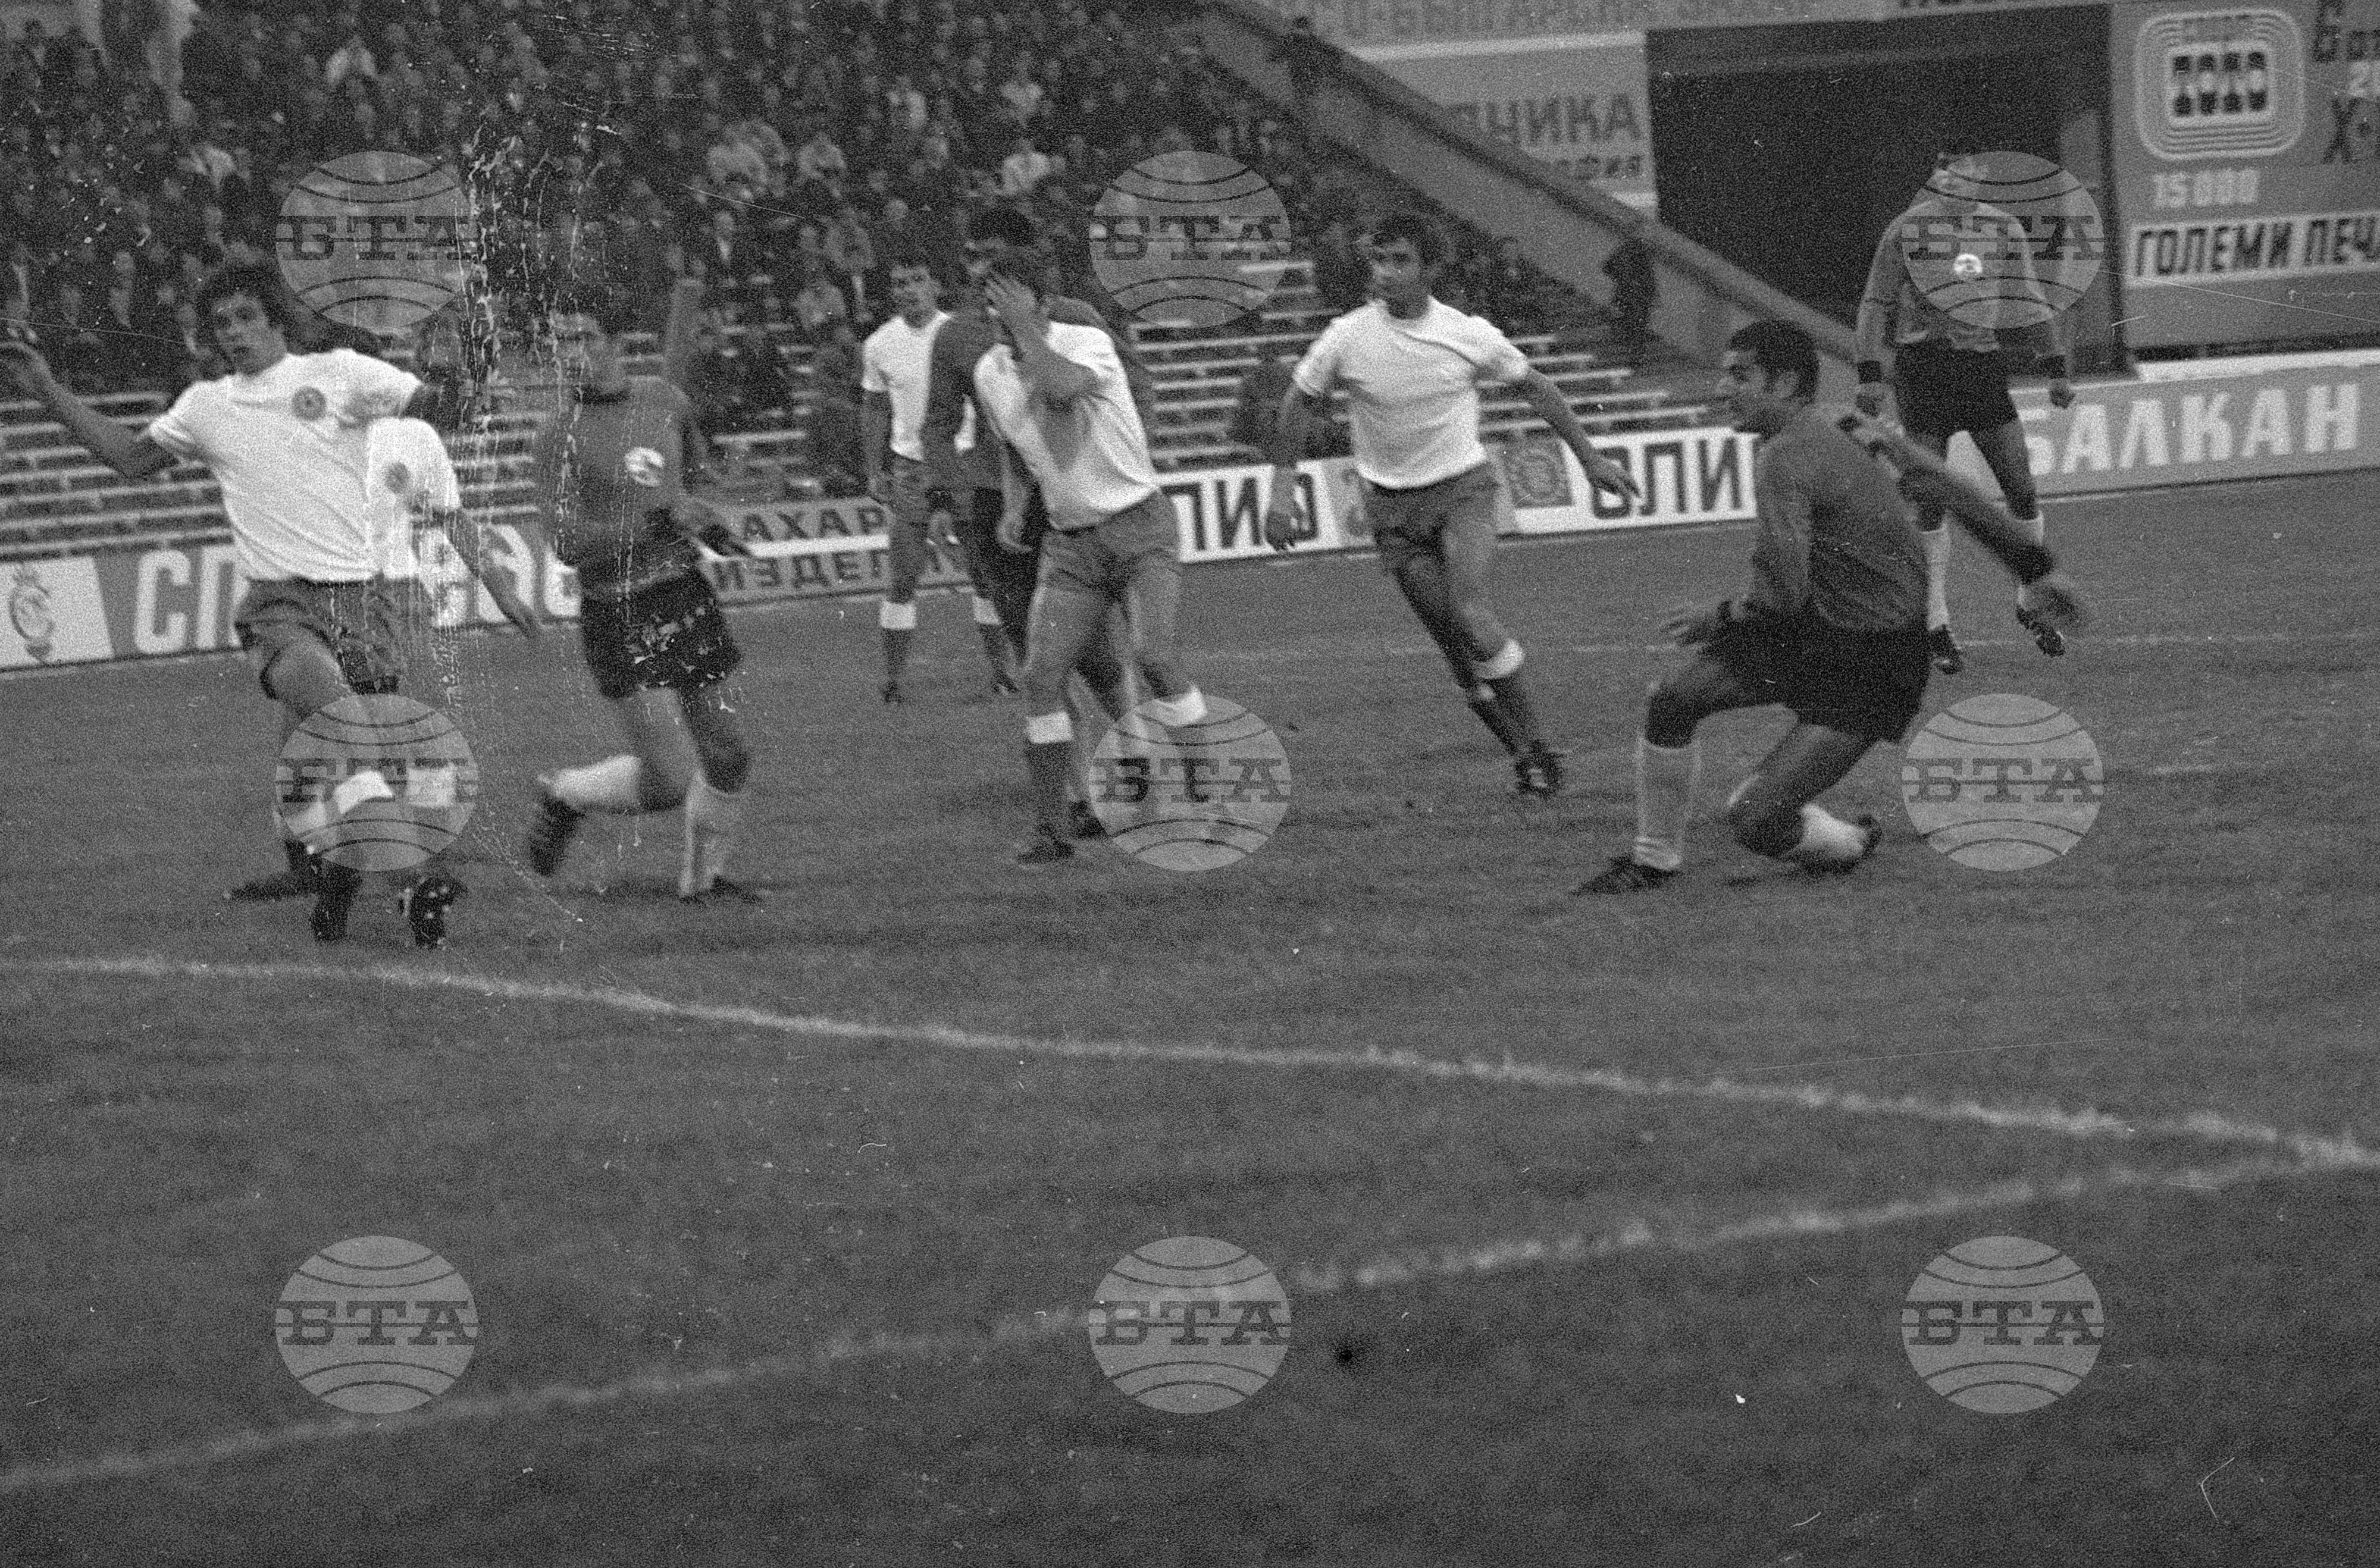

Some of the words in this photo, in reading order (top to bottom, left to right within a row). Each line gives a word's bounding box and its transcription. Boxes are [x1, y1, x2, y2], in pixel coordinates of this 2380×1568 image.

[2136, 222, 2293, 277] ГОЛЕМИ
[2017, 382, 2361, 476] БАЛКАН
[1590, 437, 1743, 518] ОЛИ
[743, 507, 885, 542] АХАР
